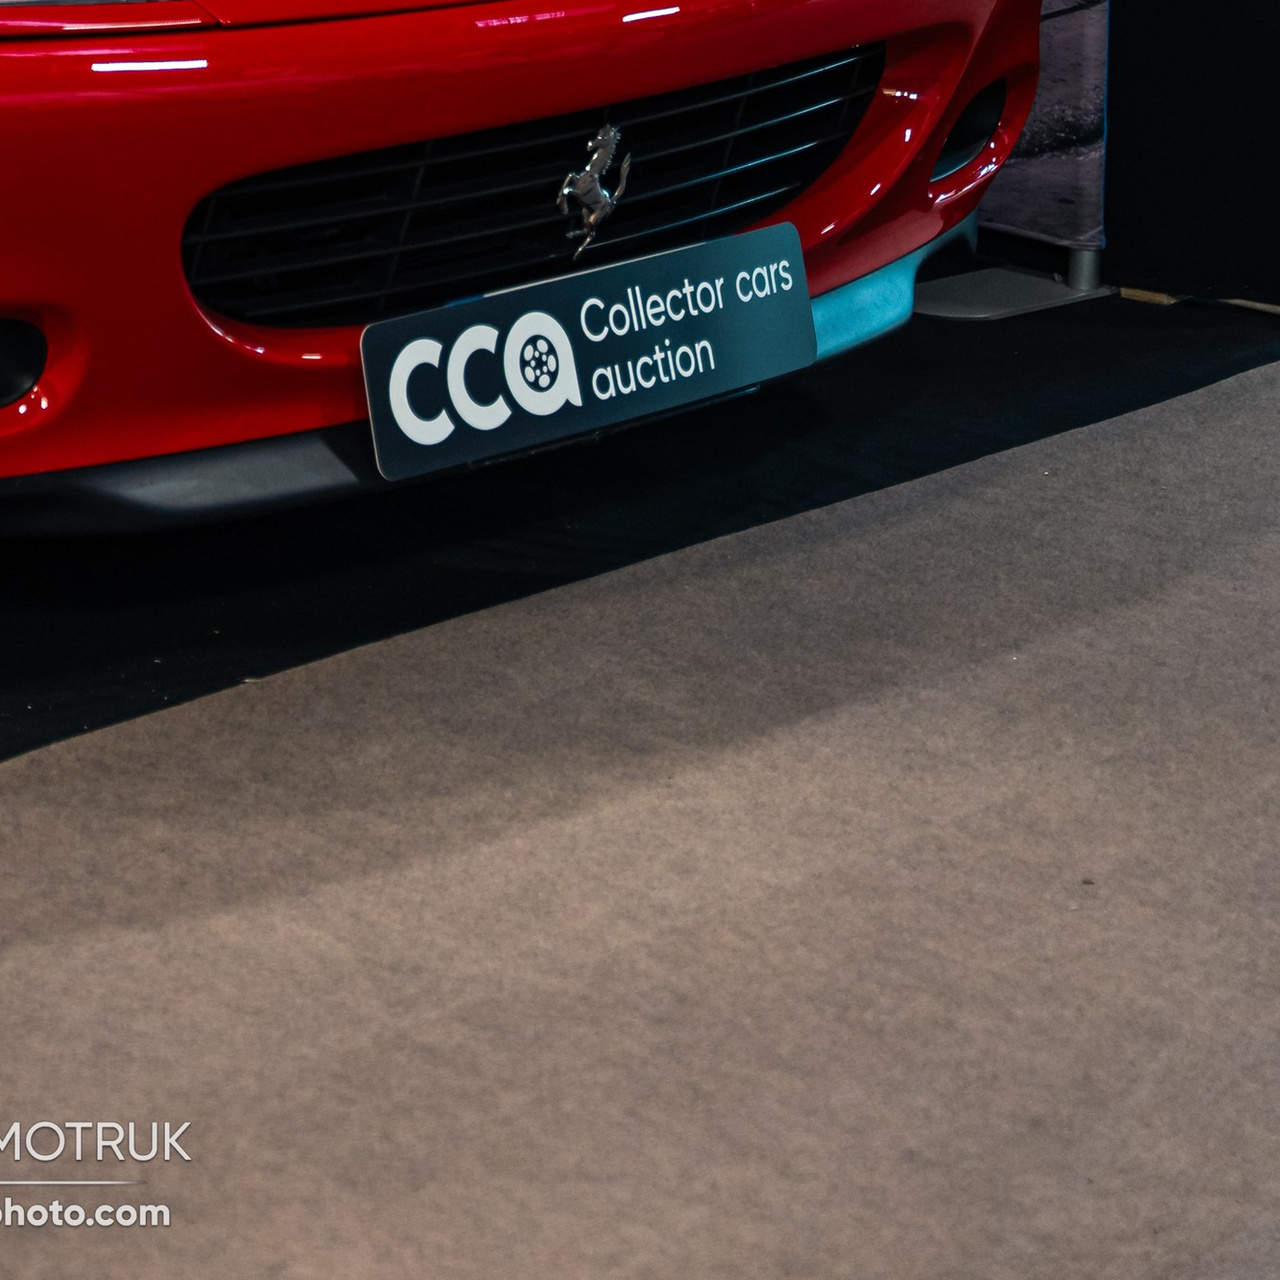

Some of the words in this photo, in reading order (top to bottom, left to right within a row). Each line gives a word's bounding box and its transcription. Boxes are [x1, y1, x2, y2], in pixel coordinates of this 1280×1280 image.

[580, 274, 725, 343] Collector
[735, 258, 793, 304] cars
[591, 338, 716, 402] auction
